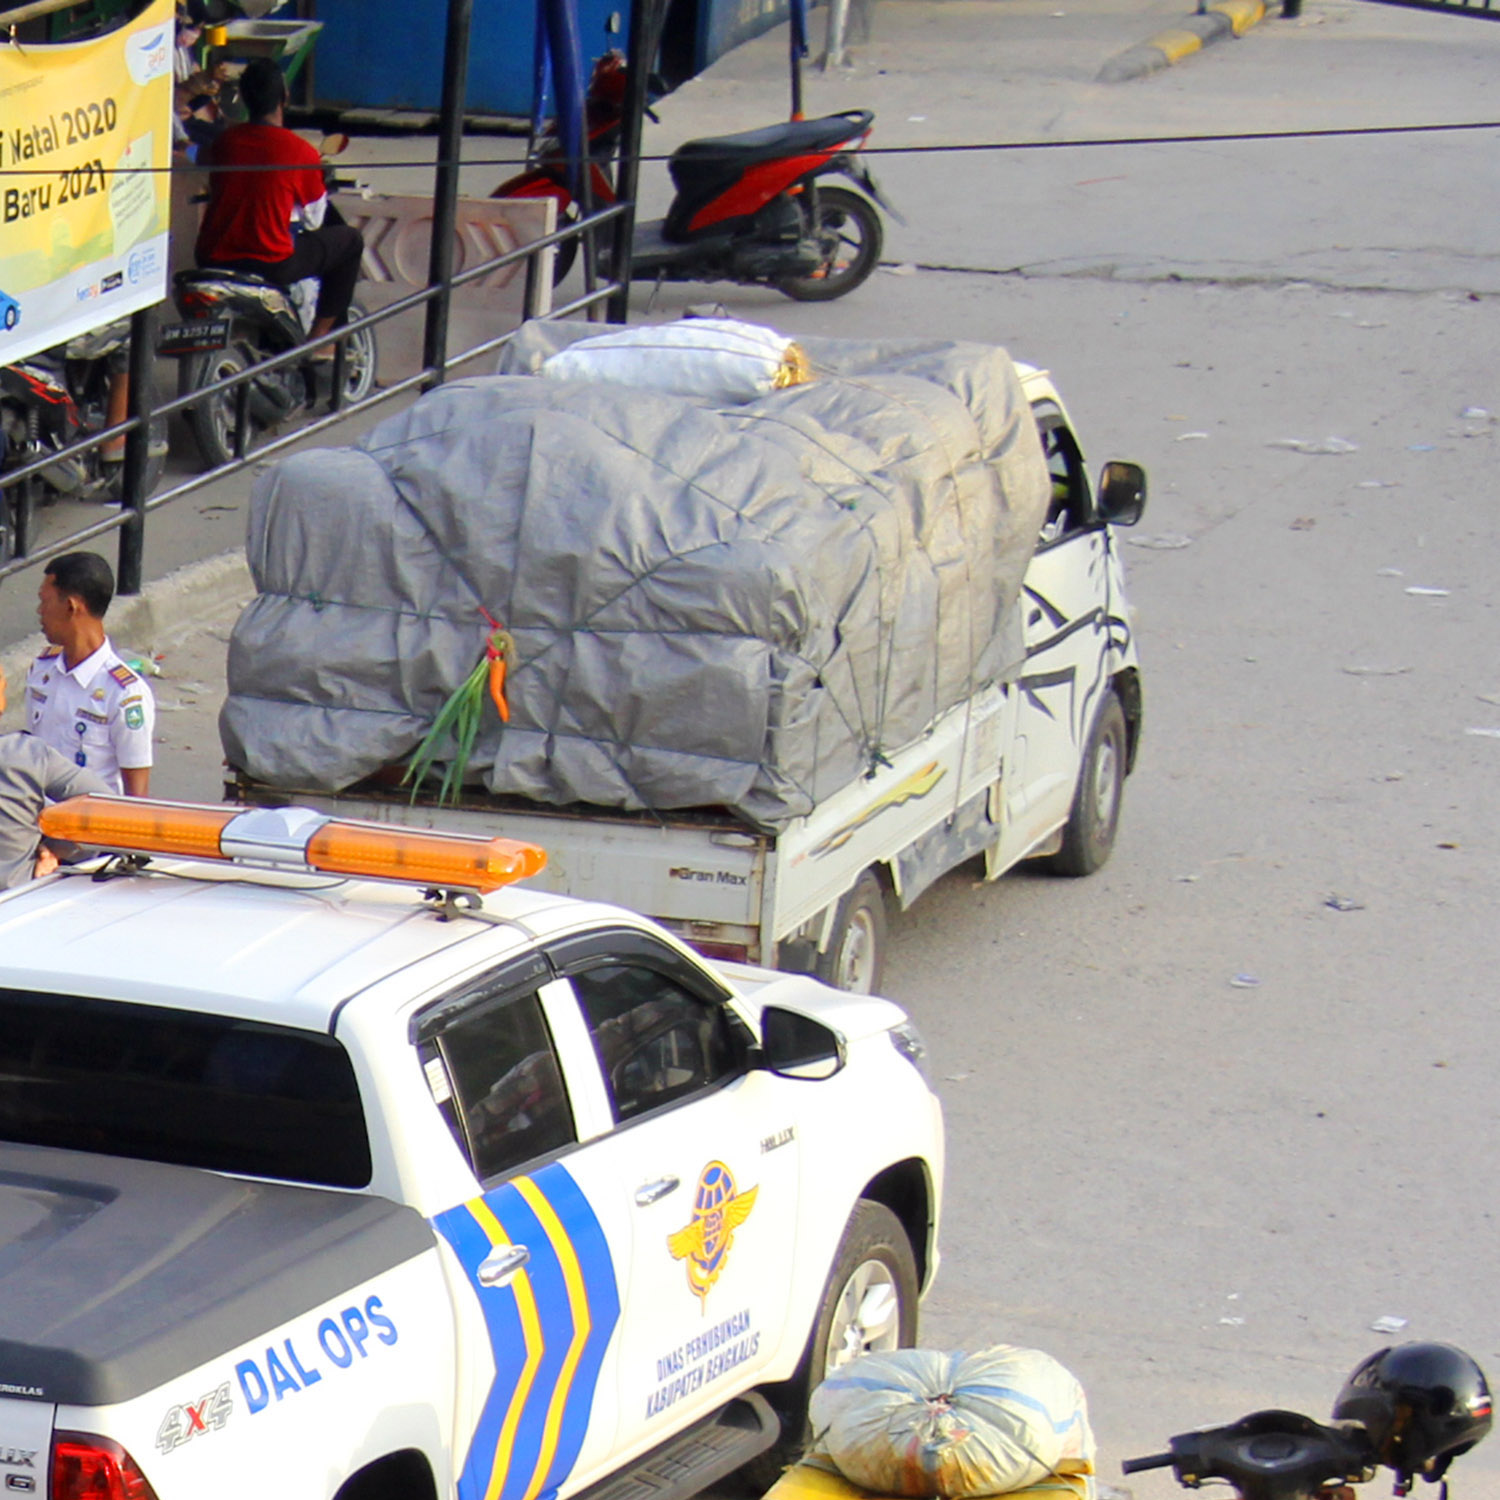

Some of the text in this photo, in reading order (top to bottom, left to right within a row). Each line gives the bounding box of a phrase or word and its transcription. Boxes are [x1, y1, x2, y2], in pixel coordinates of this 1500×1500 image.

[9, 115, 59, 166] Natal
[62, 97, 117, 146] 2020
[4, 184, 51, 224] Baru
[57, 159, 106, 205] 2021
[679, 867, 747, 886] Gran Max
[235, 1294, 399, 1415] DAL OPS
[645, 1331, 760, 1421] KABUPATEN BENGKALIS
[656, 1308, 752, 1383] DINAS PERHUBUNGAN
